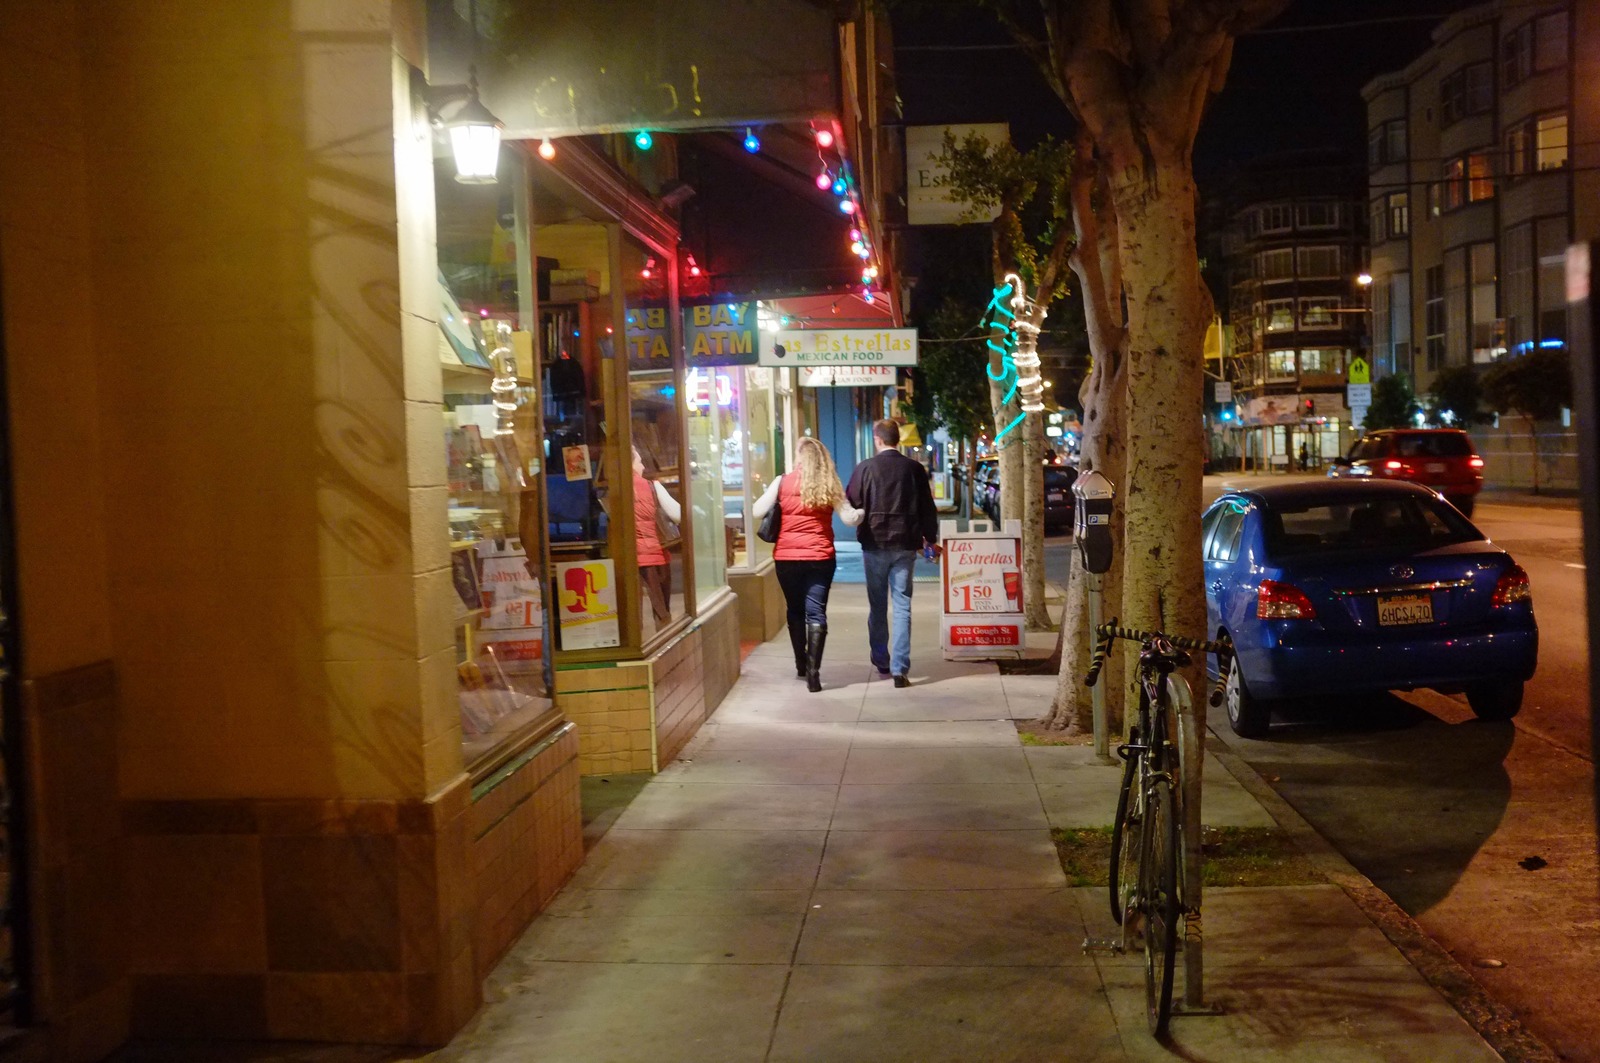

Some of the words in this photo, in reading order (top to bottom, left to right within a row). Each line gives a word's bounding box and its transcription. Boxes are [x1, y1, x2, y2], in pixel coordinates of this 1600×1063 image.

[693, 302, 749, 328] BAY
[692, 330, 753, 357] ATM
[814, 332, 911, 352] Estrellas
[796, 351, 848, 361] MEXICAN
[853, 351, 884, 361] FOOD
[951, 541, 973, 552] Las
[959, 552, 1014, 565] Estrellas
[1381, 605, 1431, 622] 6HCS470
[956, 627, 971, 635] 332
[973, 627, 999, 636] Gough
